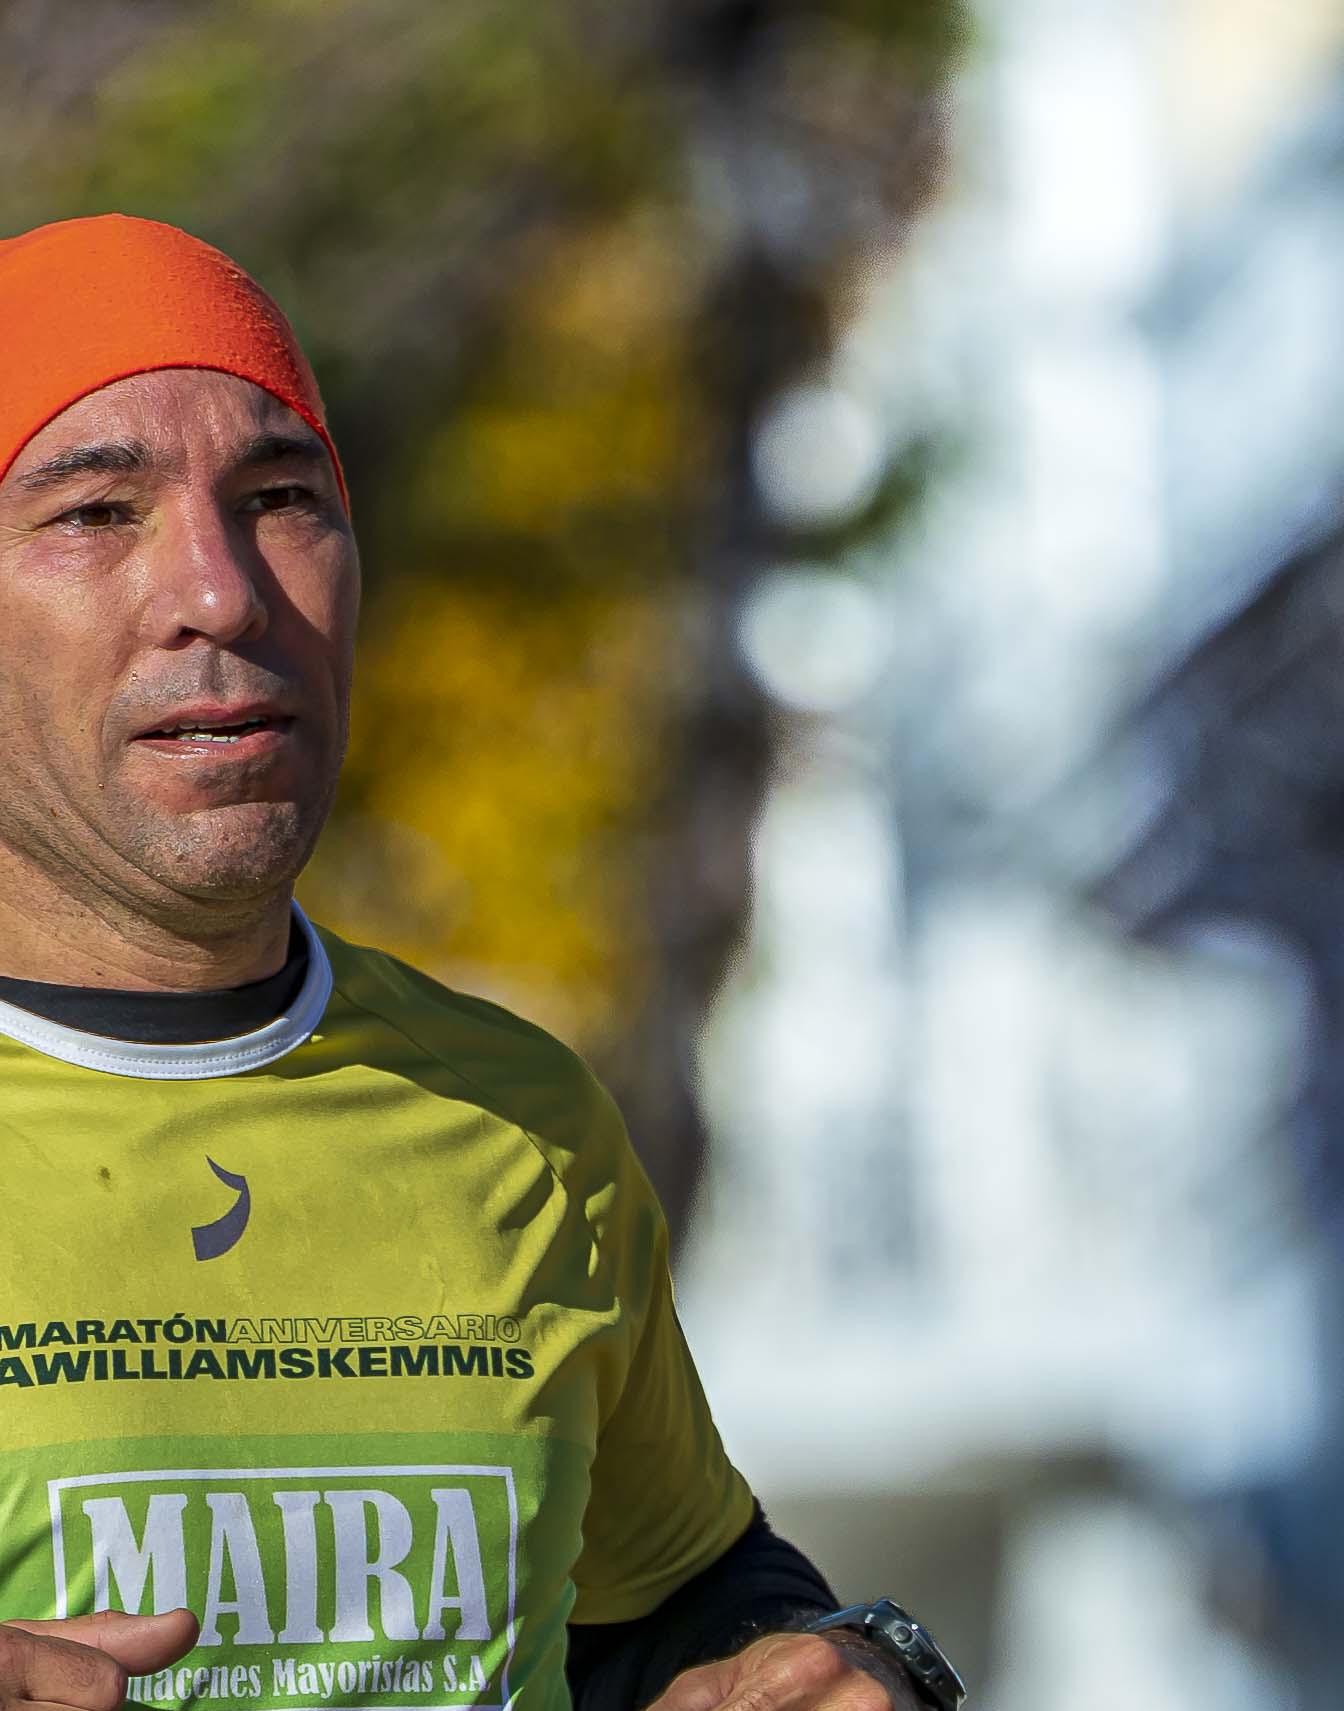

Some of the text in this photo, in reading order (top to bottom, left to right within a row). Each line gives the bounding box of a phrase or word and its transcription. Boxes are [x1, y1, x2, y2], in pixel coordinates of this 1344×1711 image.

[226, 1314, 522, 1344] ANIVERSARIO
[82, 1488, 492, 1647] MAIRA
[126, 1666, 261, 1702] macenes
[272, 1655, 433, 1700] Mayoristas
